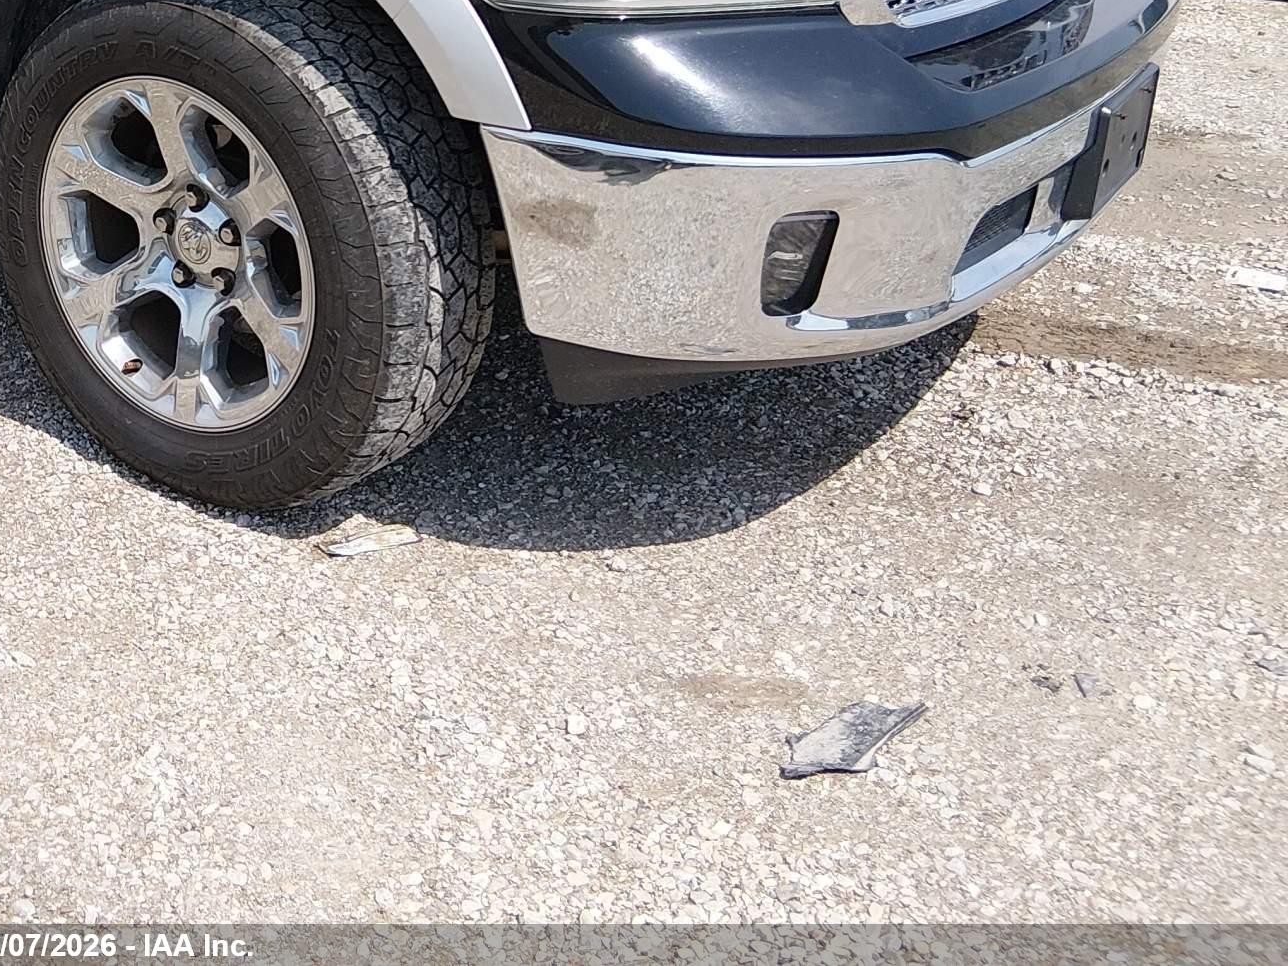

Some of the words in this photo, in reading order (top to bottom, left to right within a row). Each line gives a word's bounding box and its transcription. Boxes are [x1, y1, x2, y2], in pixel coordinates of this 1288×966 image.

[16, 40, 120, 154] COUNTRY
[7, 154, 28, 268] OPEN
[184, 425, 291, 474] TIRES
